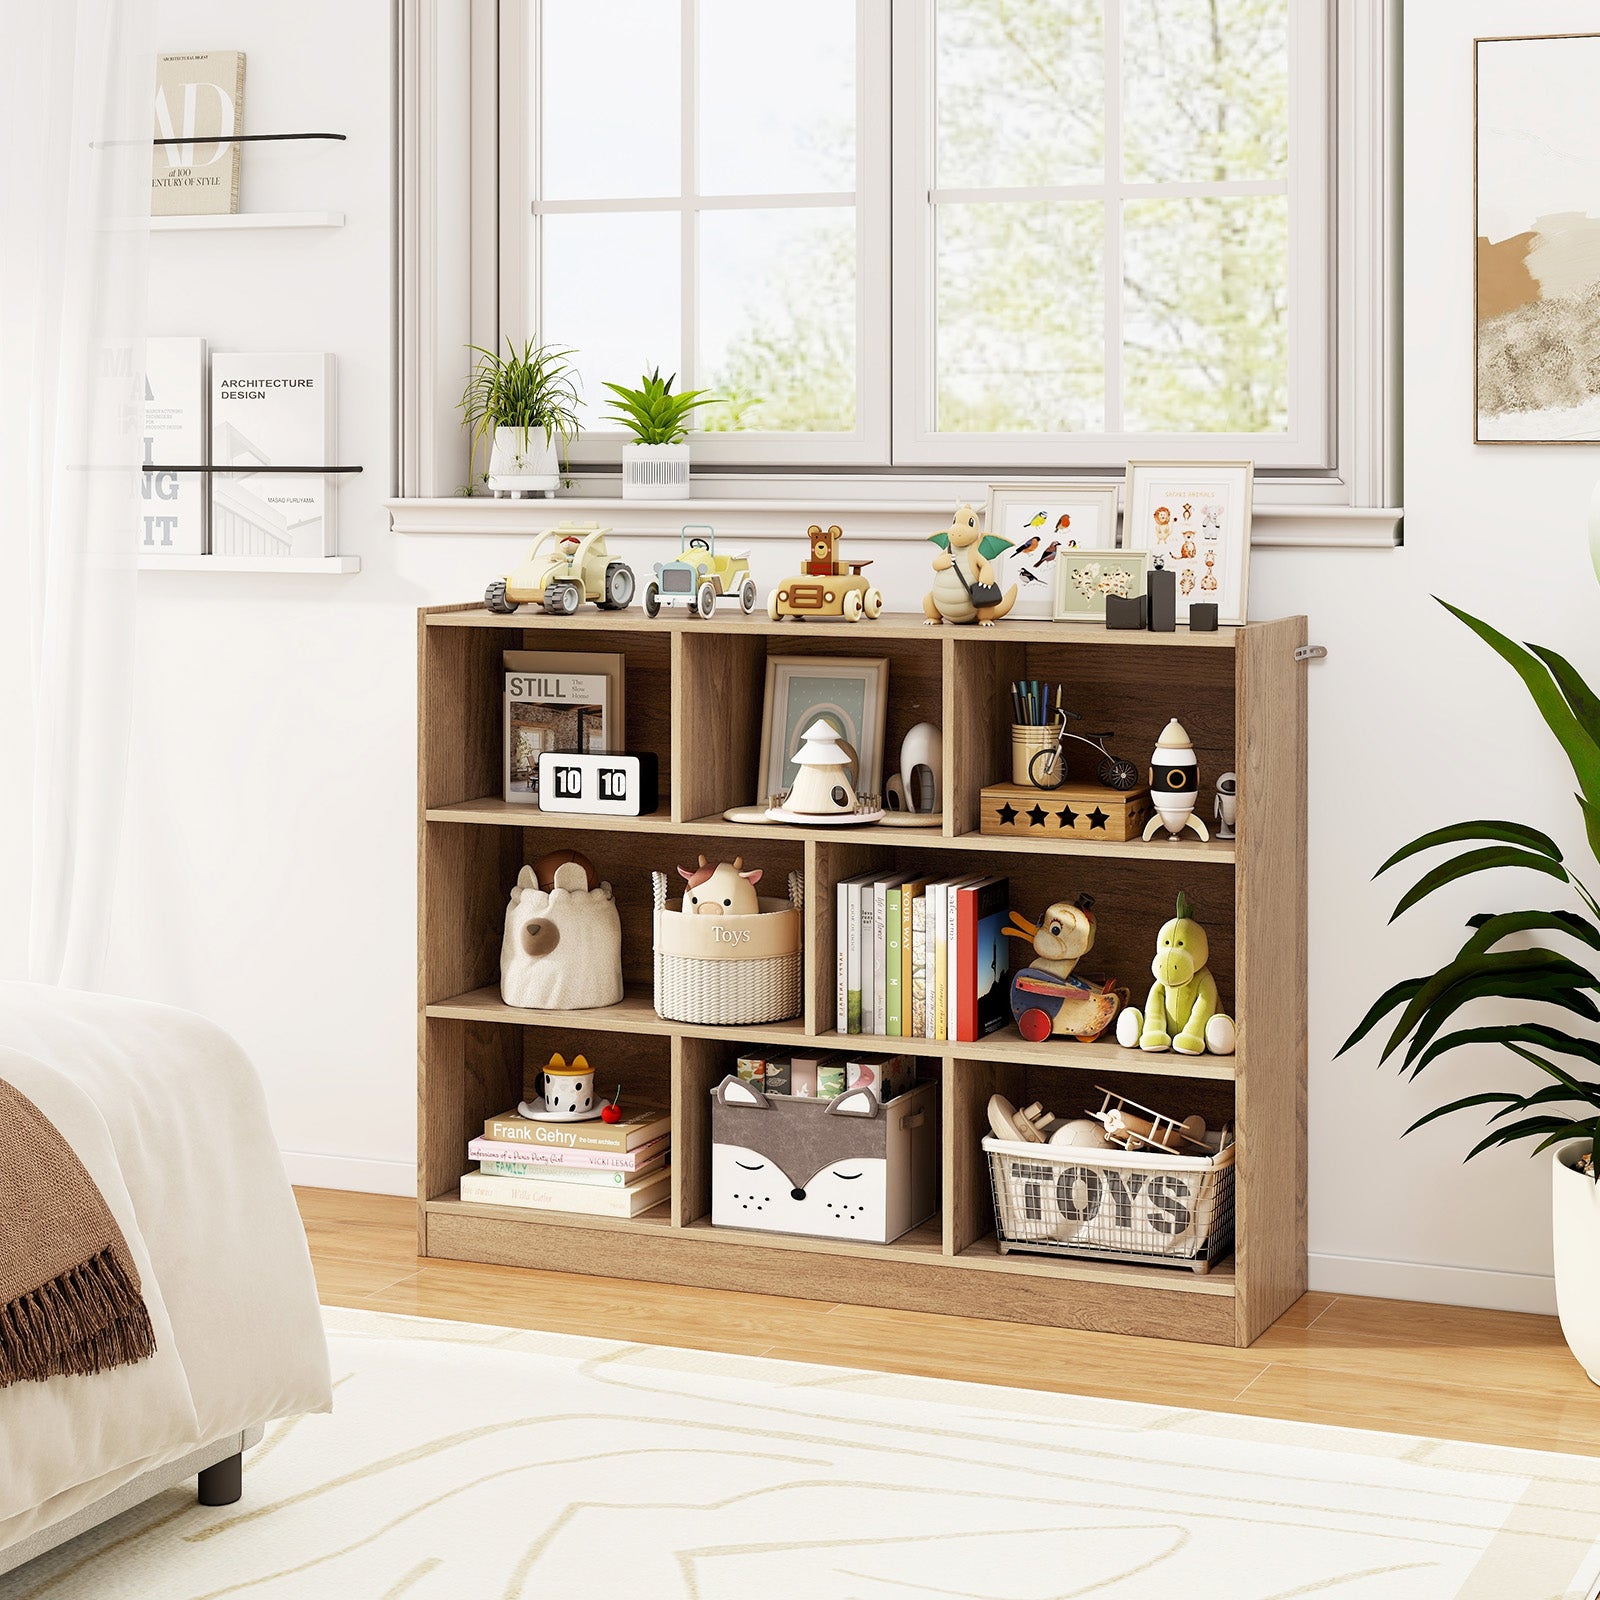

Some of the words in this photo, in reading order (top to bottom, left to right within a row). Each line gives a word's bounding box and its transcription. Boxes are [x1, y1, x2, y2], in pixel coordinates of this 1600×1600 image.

[152, 178, 183, 187] ENTURY
[184, 178, 194, 186] OF
[196, 177, 220, 186] STYLE
[221, 379, 314, 388] ARCHITECTURE
[221, 391, 265, 399] DESIGN
[143, 516, 178, 545] IT
[510, 677, 566, 698] STILL
[557, 770, 581, 794] 10
[602, 772, 626, 796] 10
[712, 926, 751, 947] Toys
[493, 1123, 531, 1140] Frank
[536, 1127, 576, 1147] Gehry
[1011, 1163, 1191, 1235] TOYS
